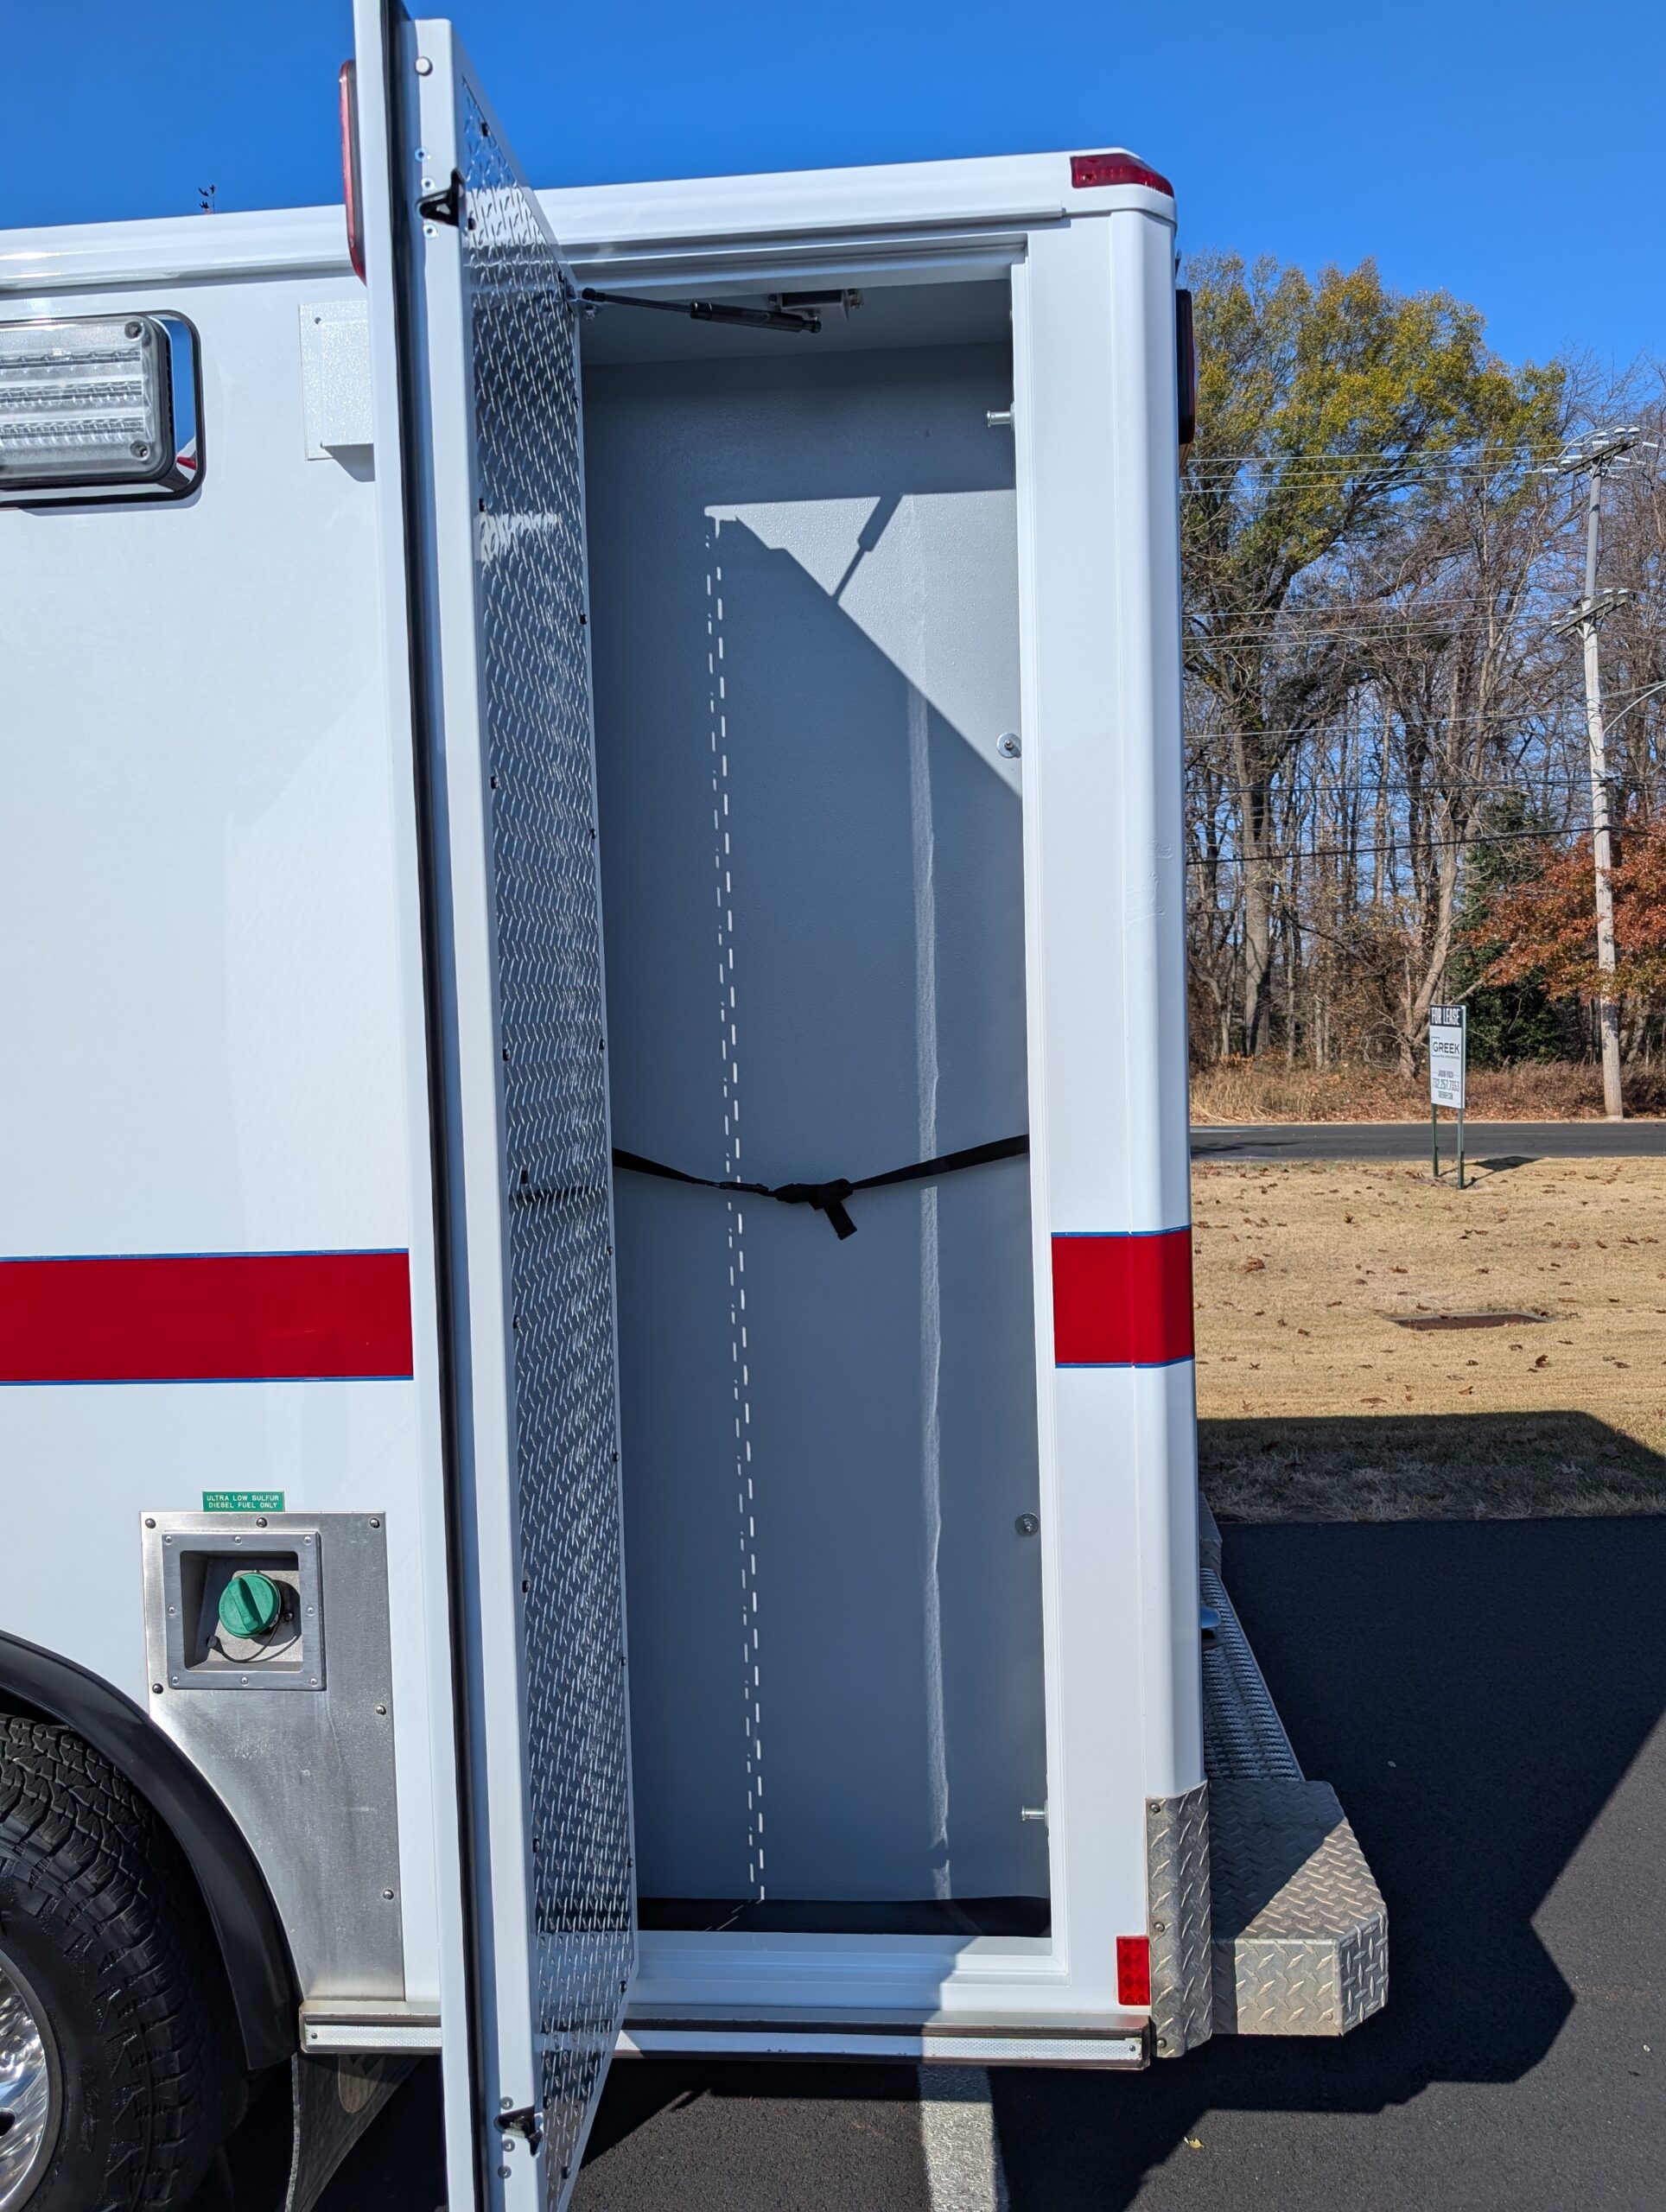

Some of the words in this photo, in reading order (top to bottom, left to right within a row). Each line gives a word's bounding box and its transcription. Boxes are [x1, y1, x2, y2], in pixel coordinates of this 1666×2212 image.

[1431, 1007, 1442, 1024] FOR
[1443, 1007, 1460, 1025] LEASE
[1433, 1041, 1459, 1054] GREEK
